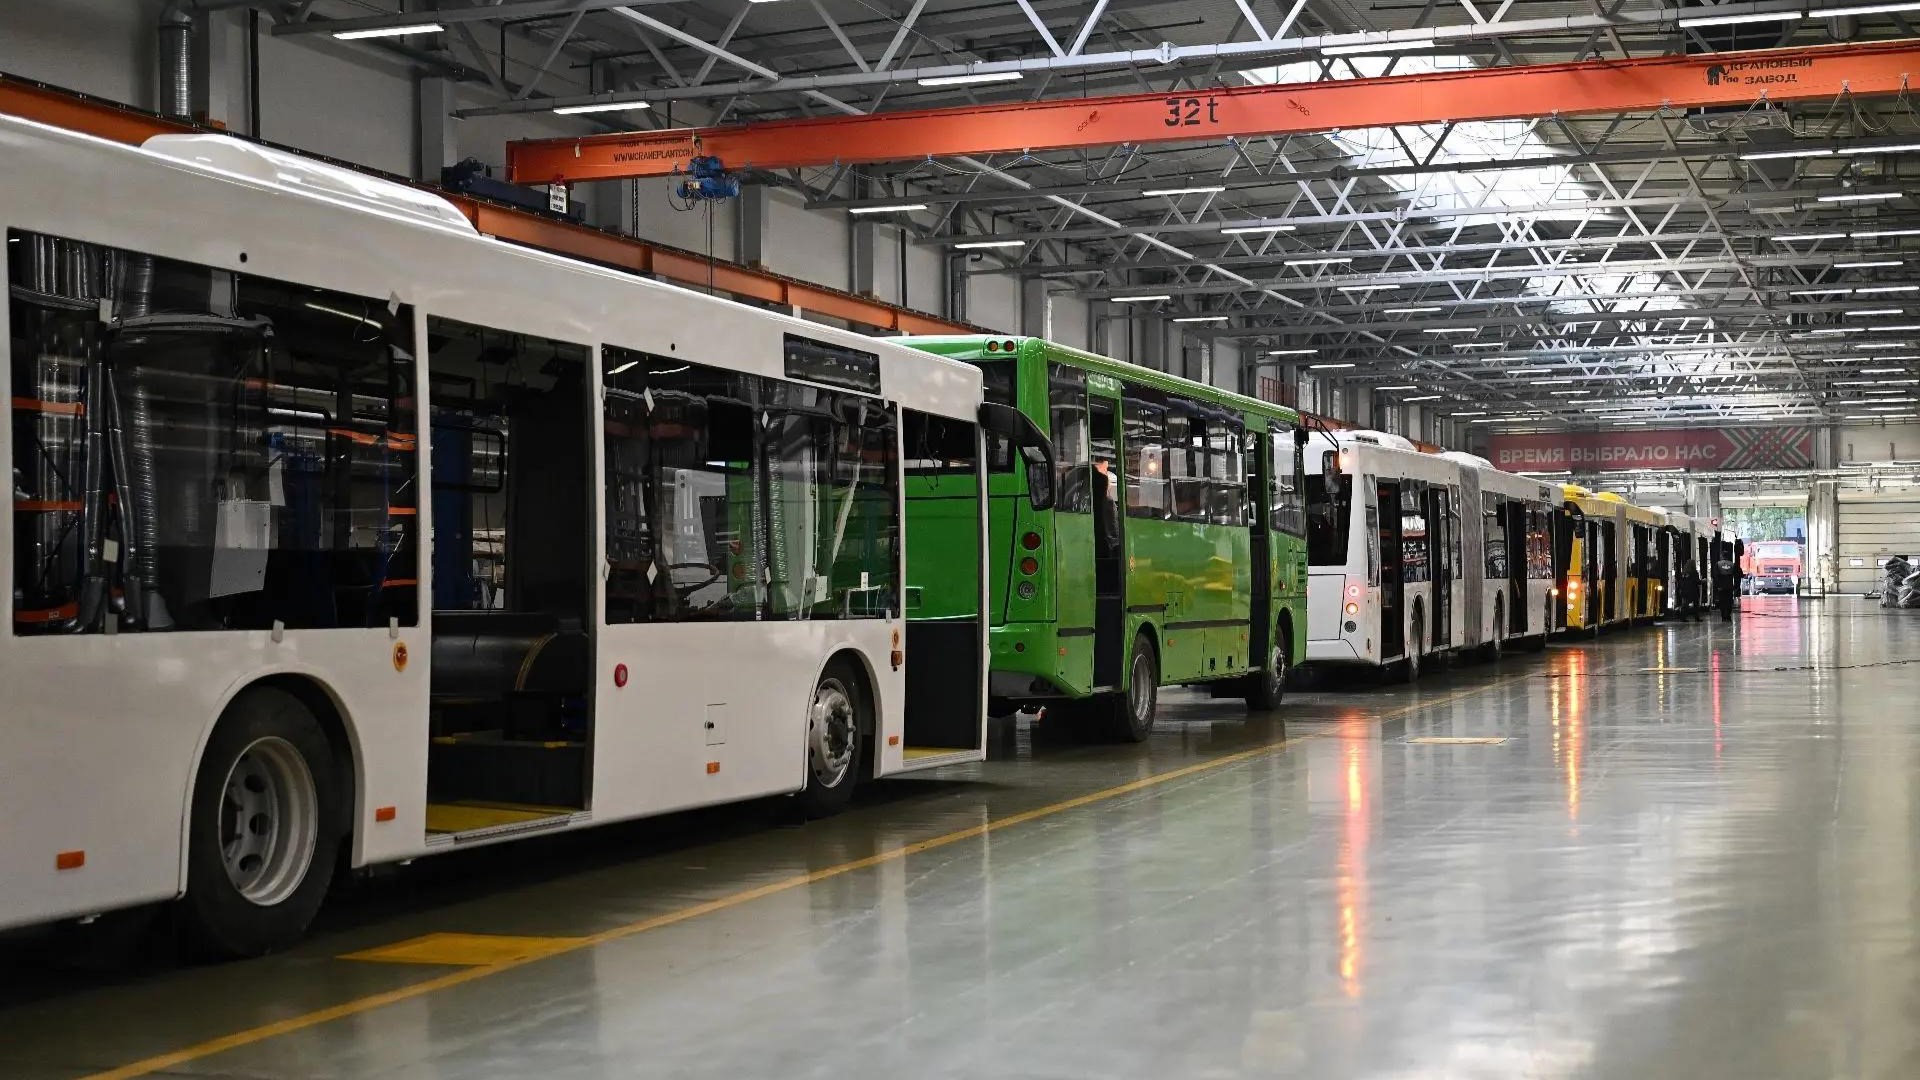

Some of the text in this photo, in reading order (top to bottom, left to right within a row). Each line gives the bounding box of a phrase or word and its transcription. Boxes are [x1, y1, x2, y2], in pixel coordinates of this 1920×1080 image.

[1745, 73, 1797, 85] ЗАВОД
[1207, 97, 1219, 124] t
[1499, 444, 1717, 463] ВРЕМЯ ВЫБРАЛО НАС
